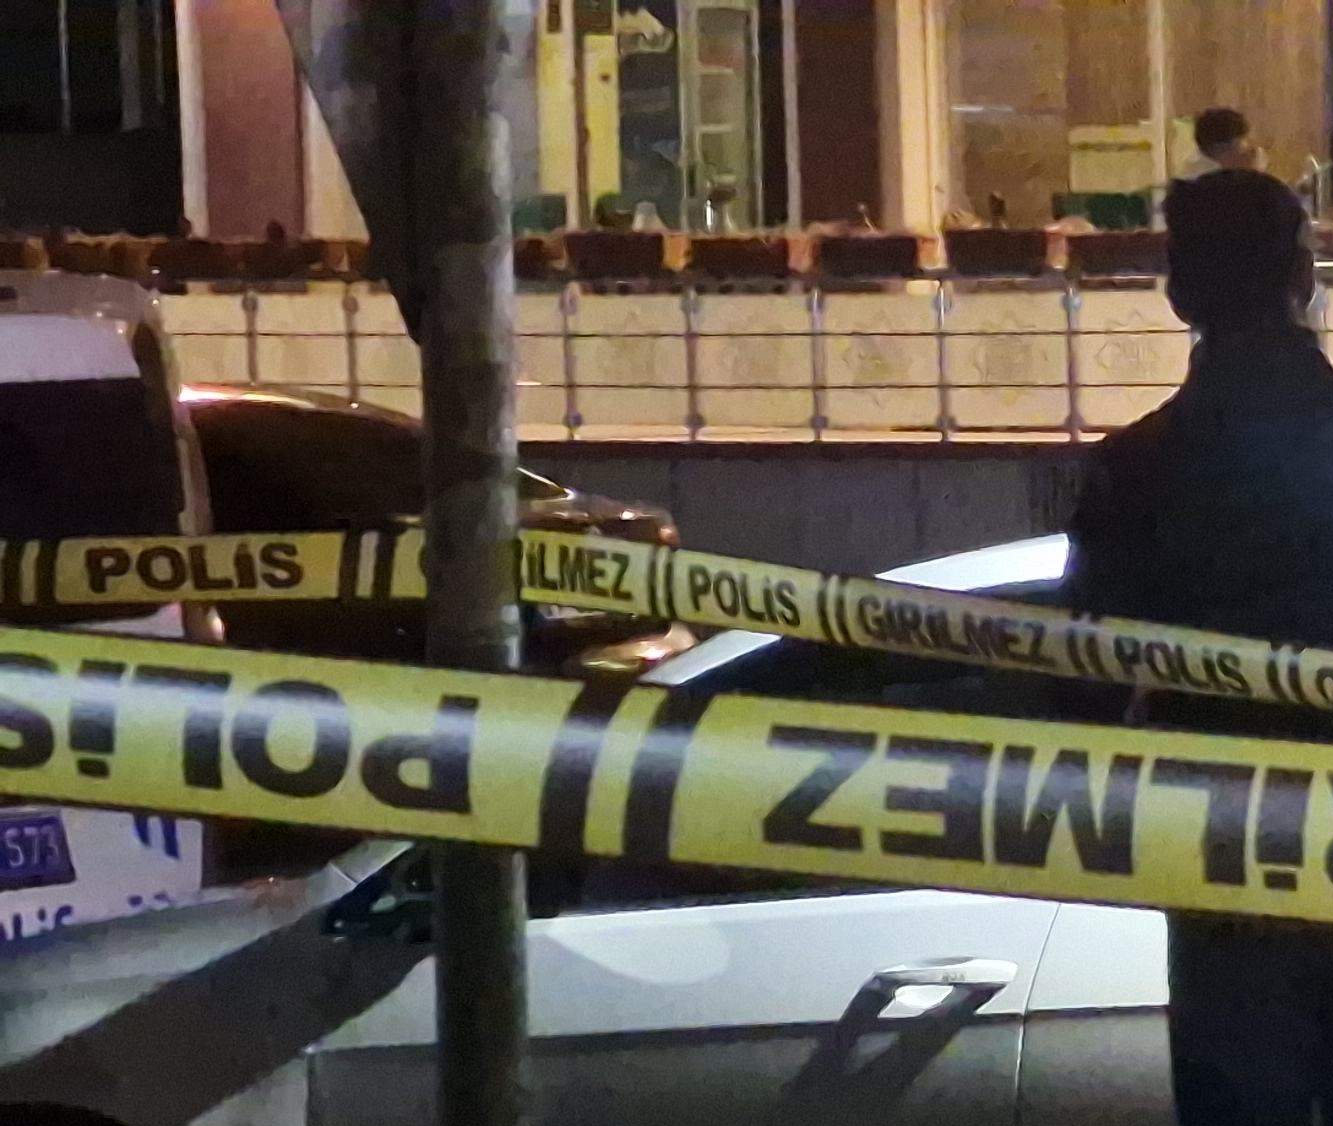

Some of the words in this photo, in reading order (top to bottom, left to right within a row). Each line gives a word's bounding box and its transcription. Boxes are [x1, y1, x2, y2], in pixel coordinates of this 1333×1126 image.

[84, 542, 305, 592] POLİS
[688, 564, 801, 627] POLİS
[1113, 634, 1253, 697] POLİS
